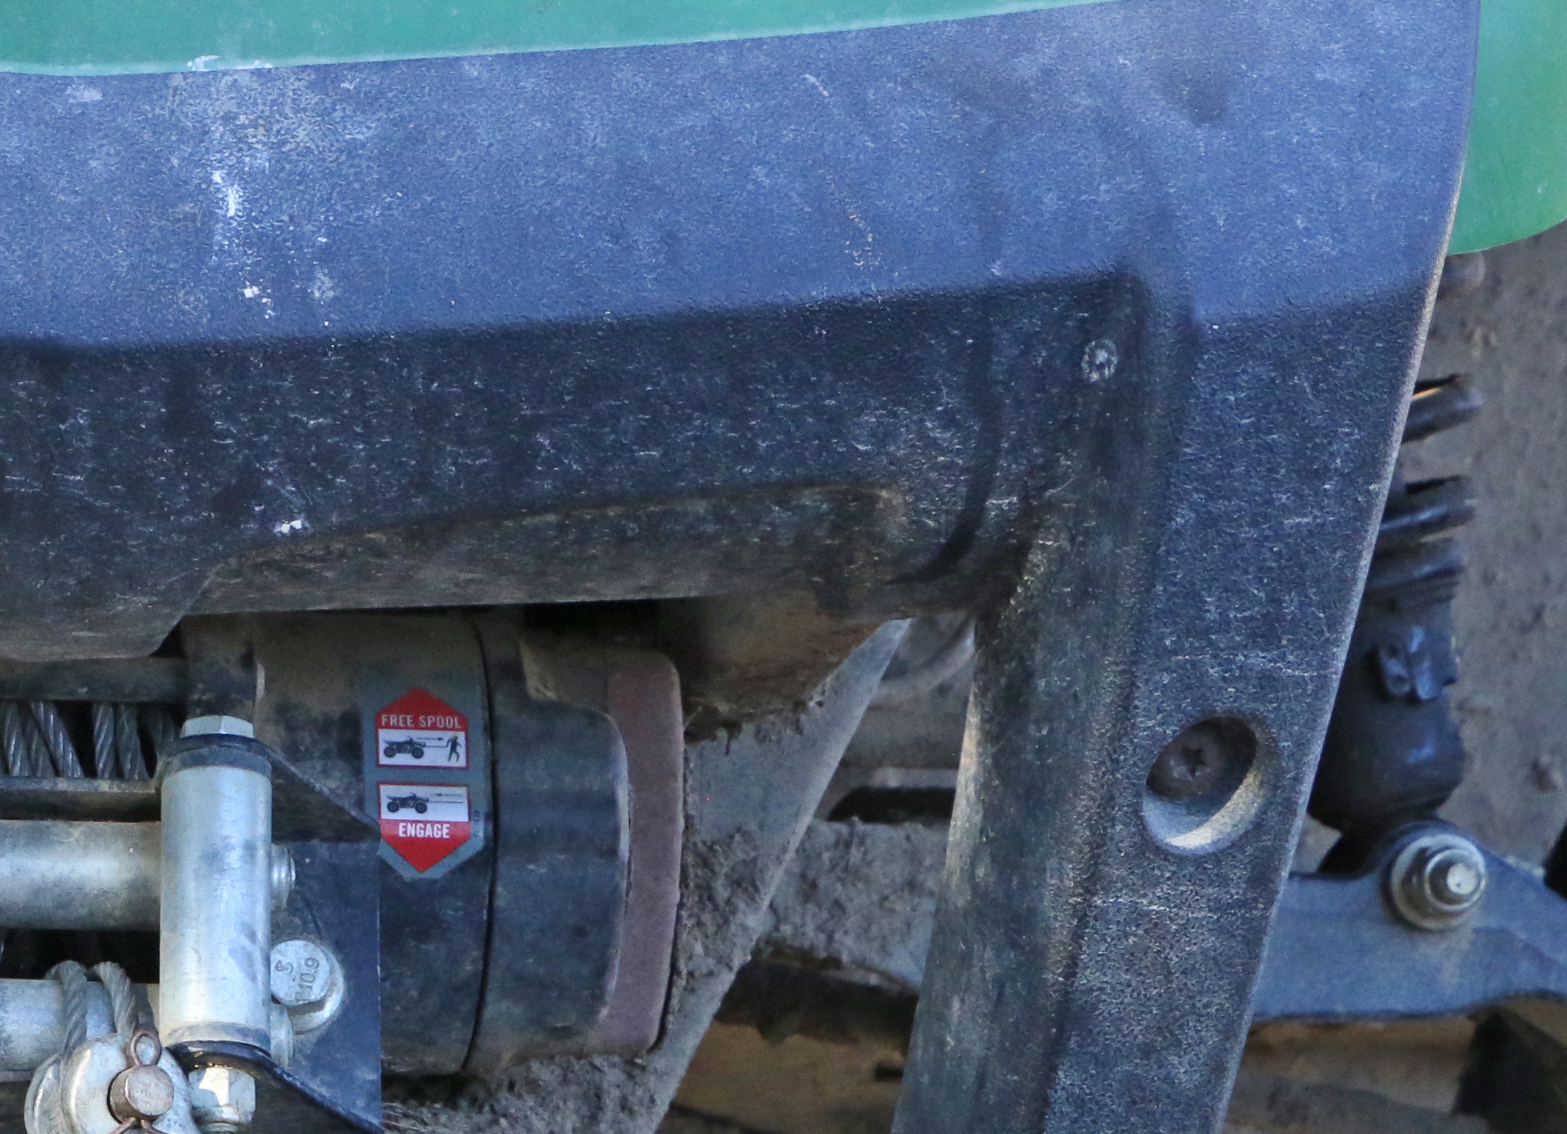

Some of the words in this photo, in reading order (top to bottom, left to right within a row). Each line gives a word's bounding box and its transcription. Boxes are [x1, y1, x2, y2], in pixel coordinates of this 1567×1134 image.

[381, 714, 415, 727] FREE
[419, 715, 461, 728] SPOOL
[398, 822, 450, 838] ENGAGE
[297, 957, 320, 990] 10.9
